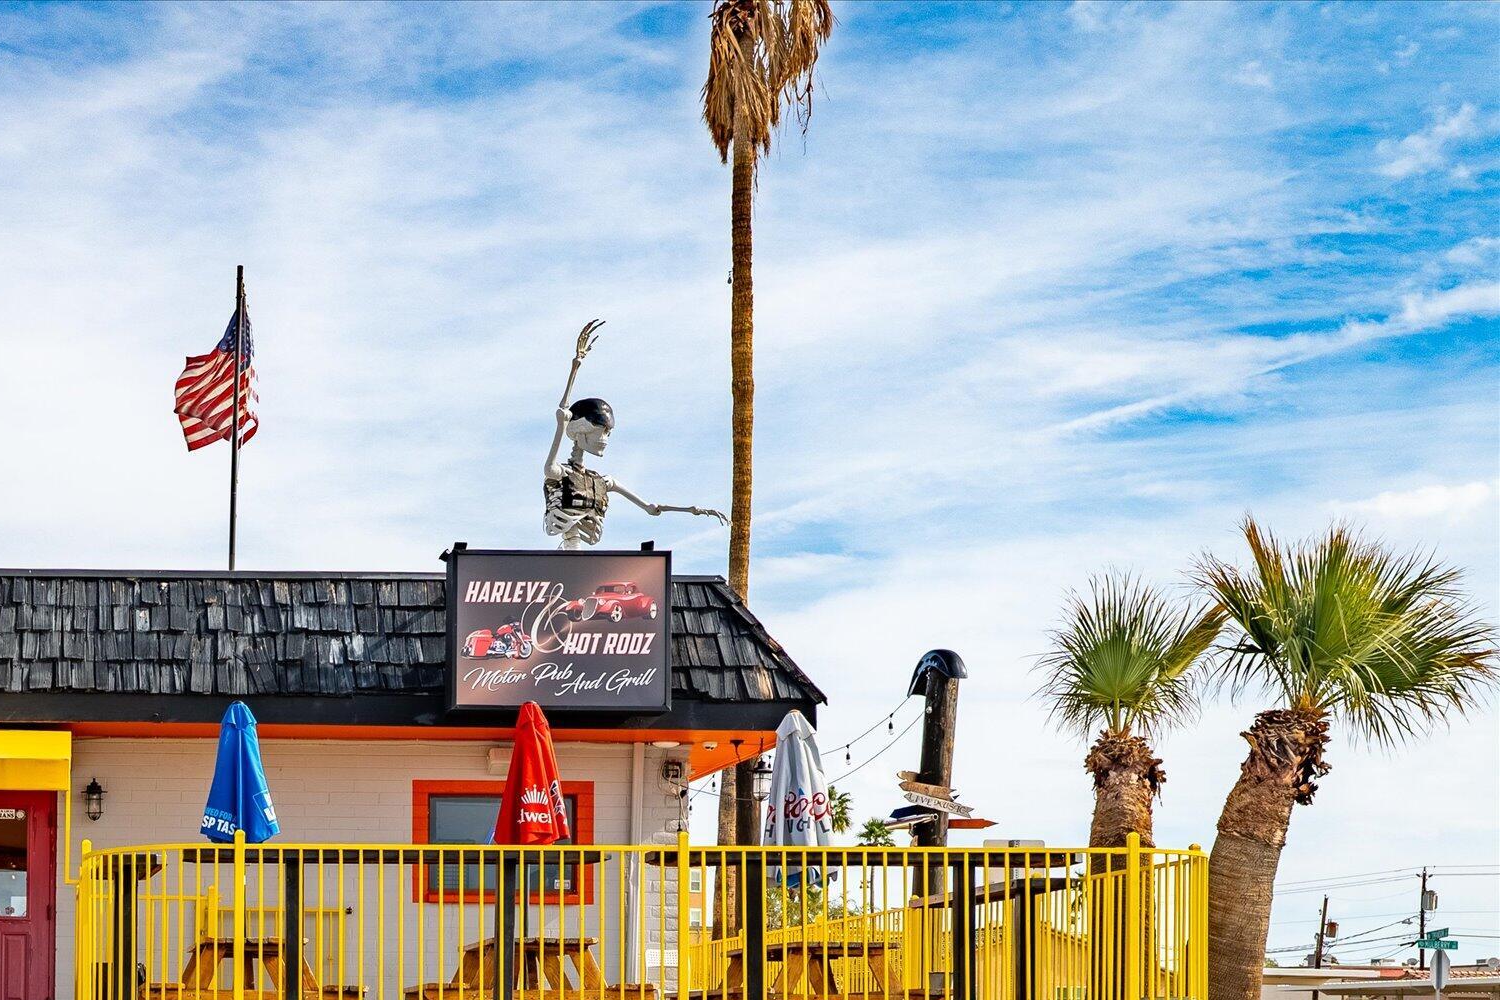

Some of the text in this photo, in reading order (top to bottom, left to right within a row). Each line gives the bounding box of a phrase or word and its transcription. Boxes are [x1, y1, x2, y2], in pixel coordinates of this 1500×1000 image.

[465, 581, 550, 603] HARLEYZ
[563, 633, 656, 655] HOT RODZ
[463, 662, 573, 692] Motor Pub
[554, 668, 657, 696] And Grill
[907, 792, 933, 808] LIVE
[218, 810, 233, 821] FOR
